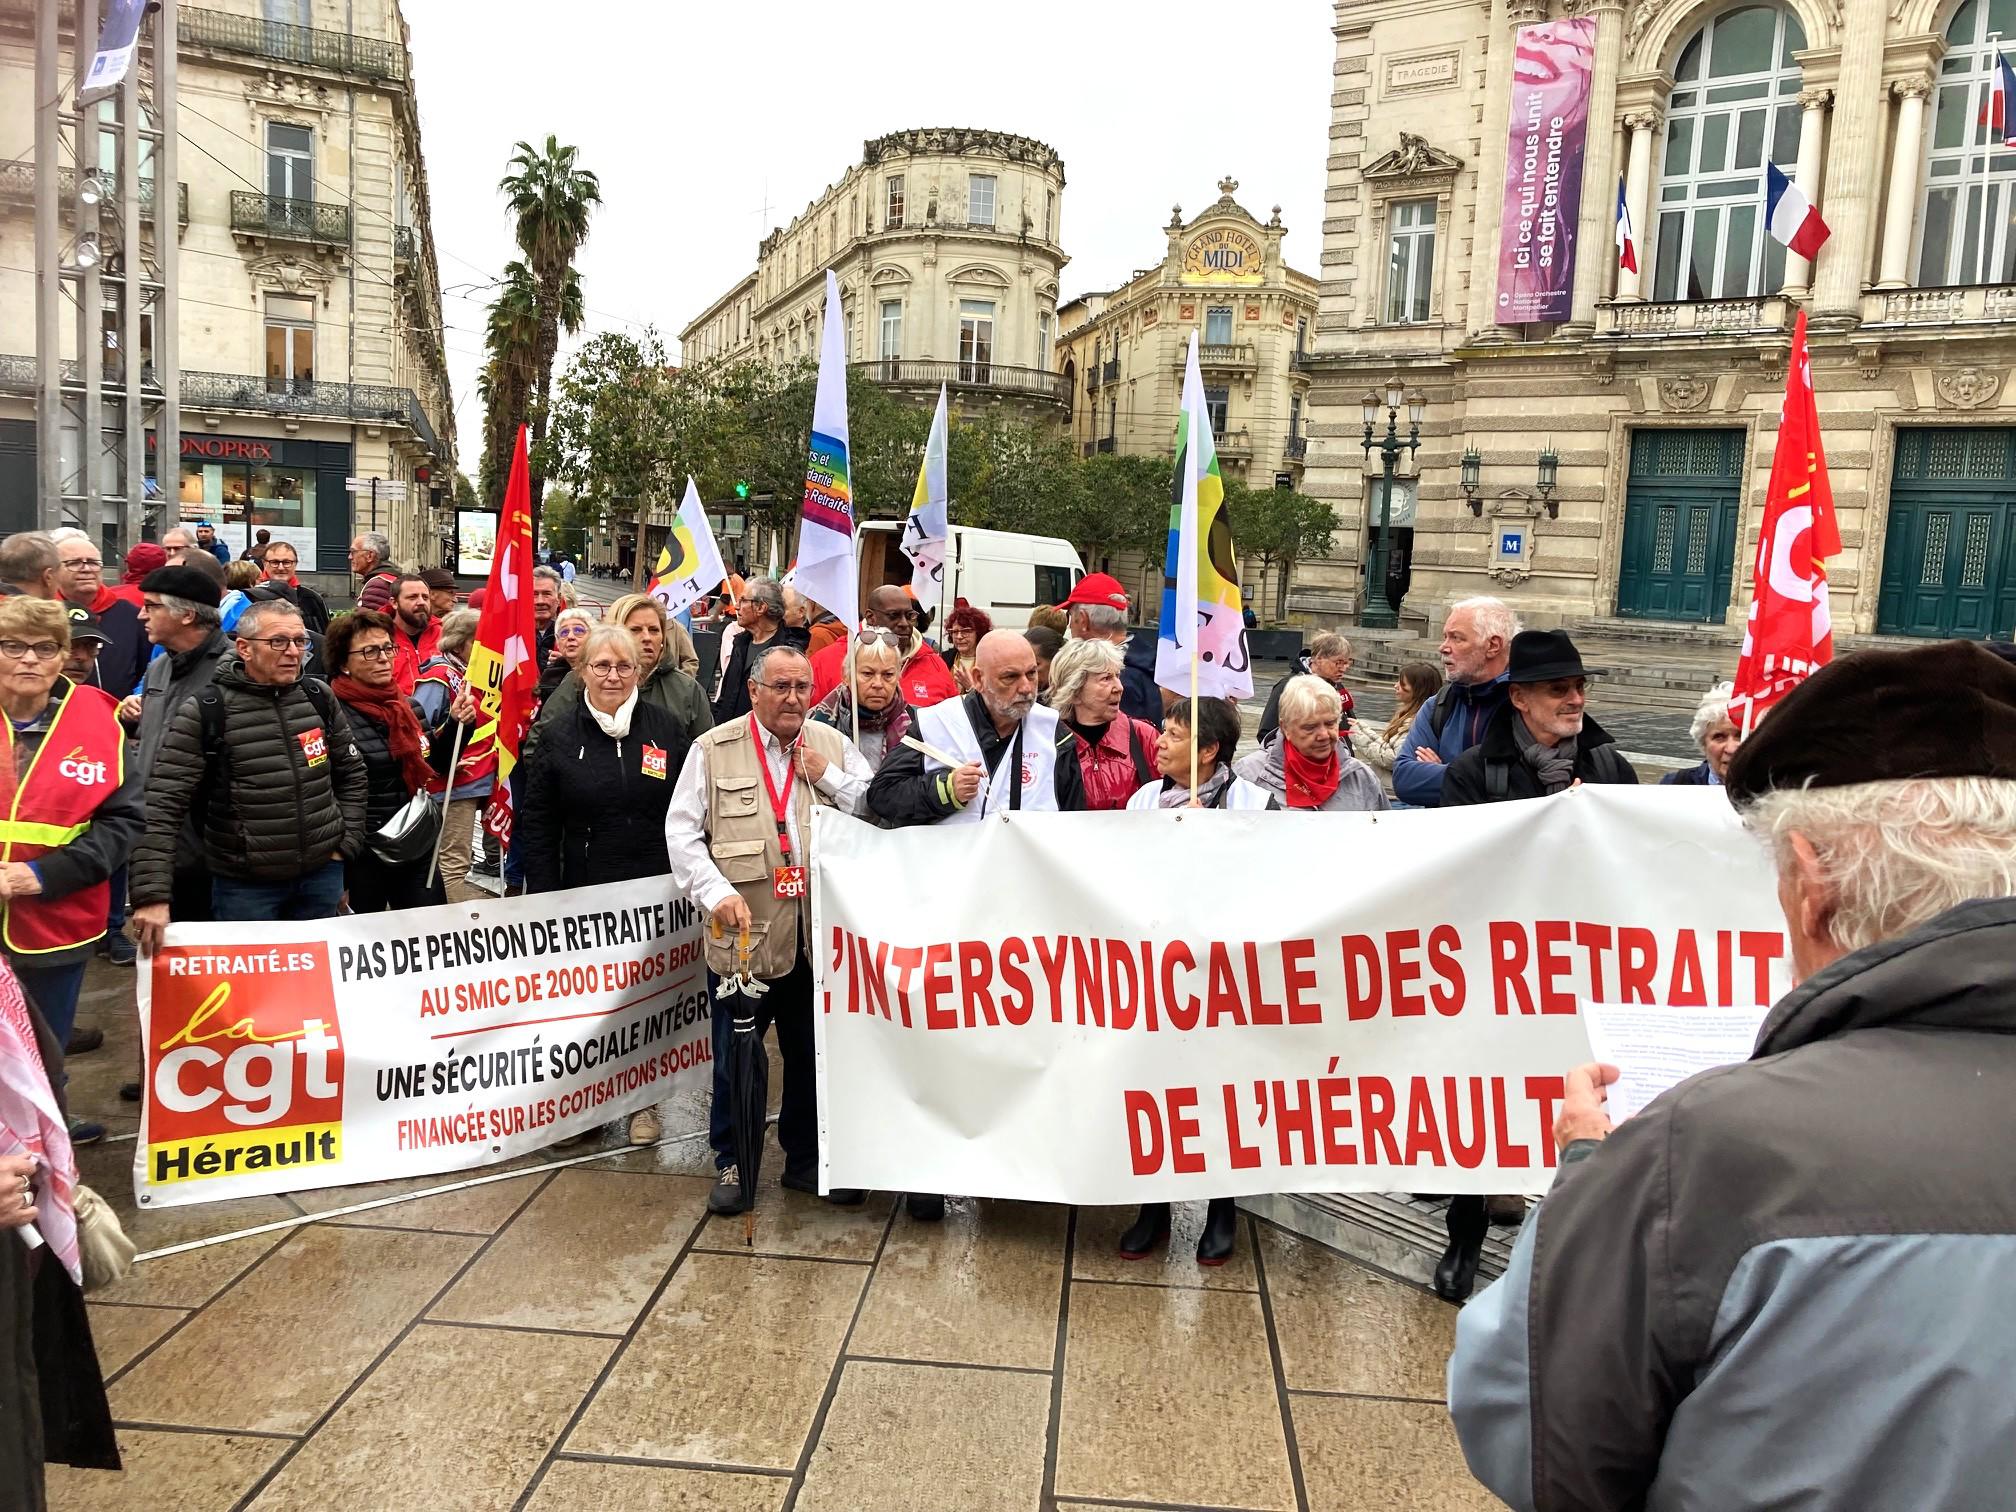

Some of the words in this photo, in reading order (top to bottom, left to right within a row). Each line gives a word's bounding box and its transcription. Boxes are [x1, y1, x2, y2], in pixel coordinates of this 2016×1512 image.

[1527, 91, 1543, 132] unit
[1524, 136, 1540, 183] nous
[1544, 116, 1564, 207] entendre
[1518, 187, 1539, 216] qui
[1520, 219, 1532, 244] ce
[1538, 209, 1557, 243] fait
[1188, 231, 1222, 260] GRAND
[1203, 250, 1243, 267] MIDI
[1514, 248, 1531, 269] Ici
[1540, 245, 1553, 268] se
[819, 454, 830, 466] et
[810, 489, 850, 514] Retraité
[1506, 540, 1518, 551] M
[304, 736, 326, 756] cgt
[59, 760, 107, 785] cgt
[643, 755, 666, 770] cgt
[776, 878, 804, 896] cgt
[338, 942, 387, 982] PAS
[390, 936, 423, 976] DE
[425, 923, 528, 970] PENSION
[530, 918, 561, 957] DE
[562, 903, 666, 952] RETRAITE
[669, 897, 703, 934] INF
[169, 949, 315, 976] RETRAITÉ.ES
[824, 926, 1323, 1032] 'INTERSYNDICALE
[1341, 923, 1467, 1021] DES
[1488, 920, 1785, 1015] RETRAIT
[420, 986, 450, 1018] AU
[454, 978, 511, 1012] SMIC
[515, 973, 543, 1004] DE
[546, 964, 599, 999] 2000
[603, 951, 666, 992] EUROS
[669, 937, 705, 971] BRU
[160, 981, 331, 1050] la
[376, 1064, 427, 1101] UNE
[431, 1033, 545, 1095] SÉCURITÉ
[549, 1020, 641, 1080] SOCIALE
[643, 990, 713, 1046] INTÉGR
[155, 1018, 339, 1126] cgt
[398, 1102, 485, 1151] FINANCÉE
[489, 1104, 525, 1138] SUR
[529, 1098, 556, 1130] LES
[559, 1058, 658, 1119] COTISATIONS
[1124, 1086, 1207, 1176] DE
[1221, 1056, 1567, 1171] L'HÉRAULT
[156, 1129, 336, 1181] Hérault
